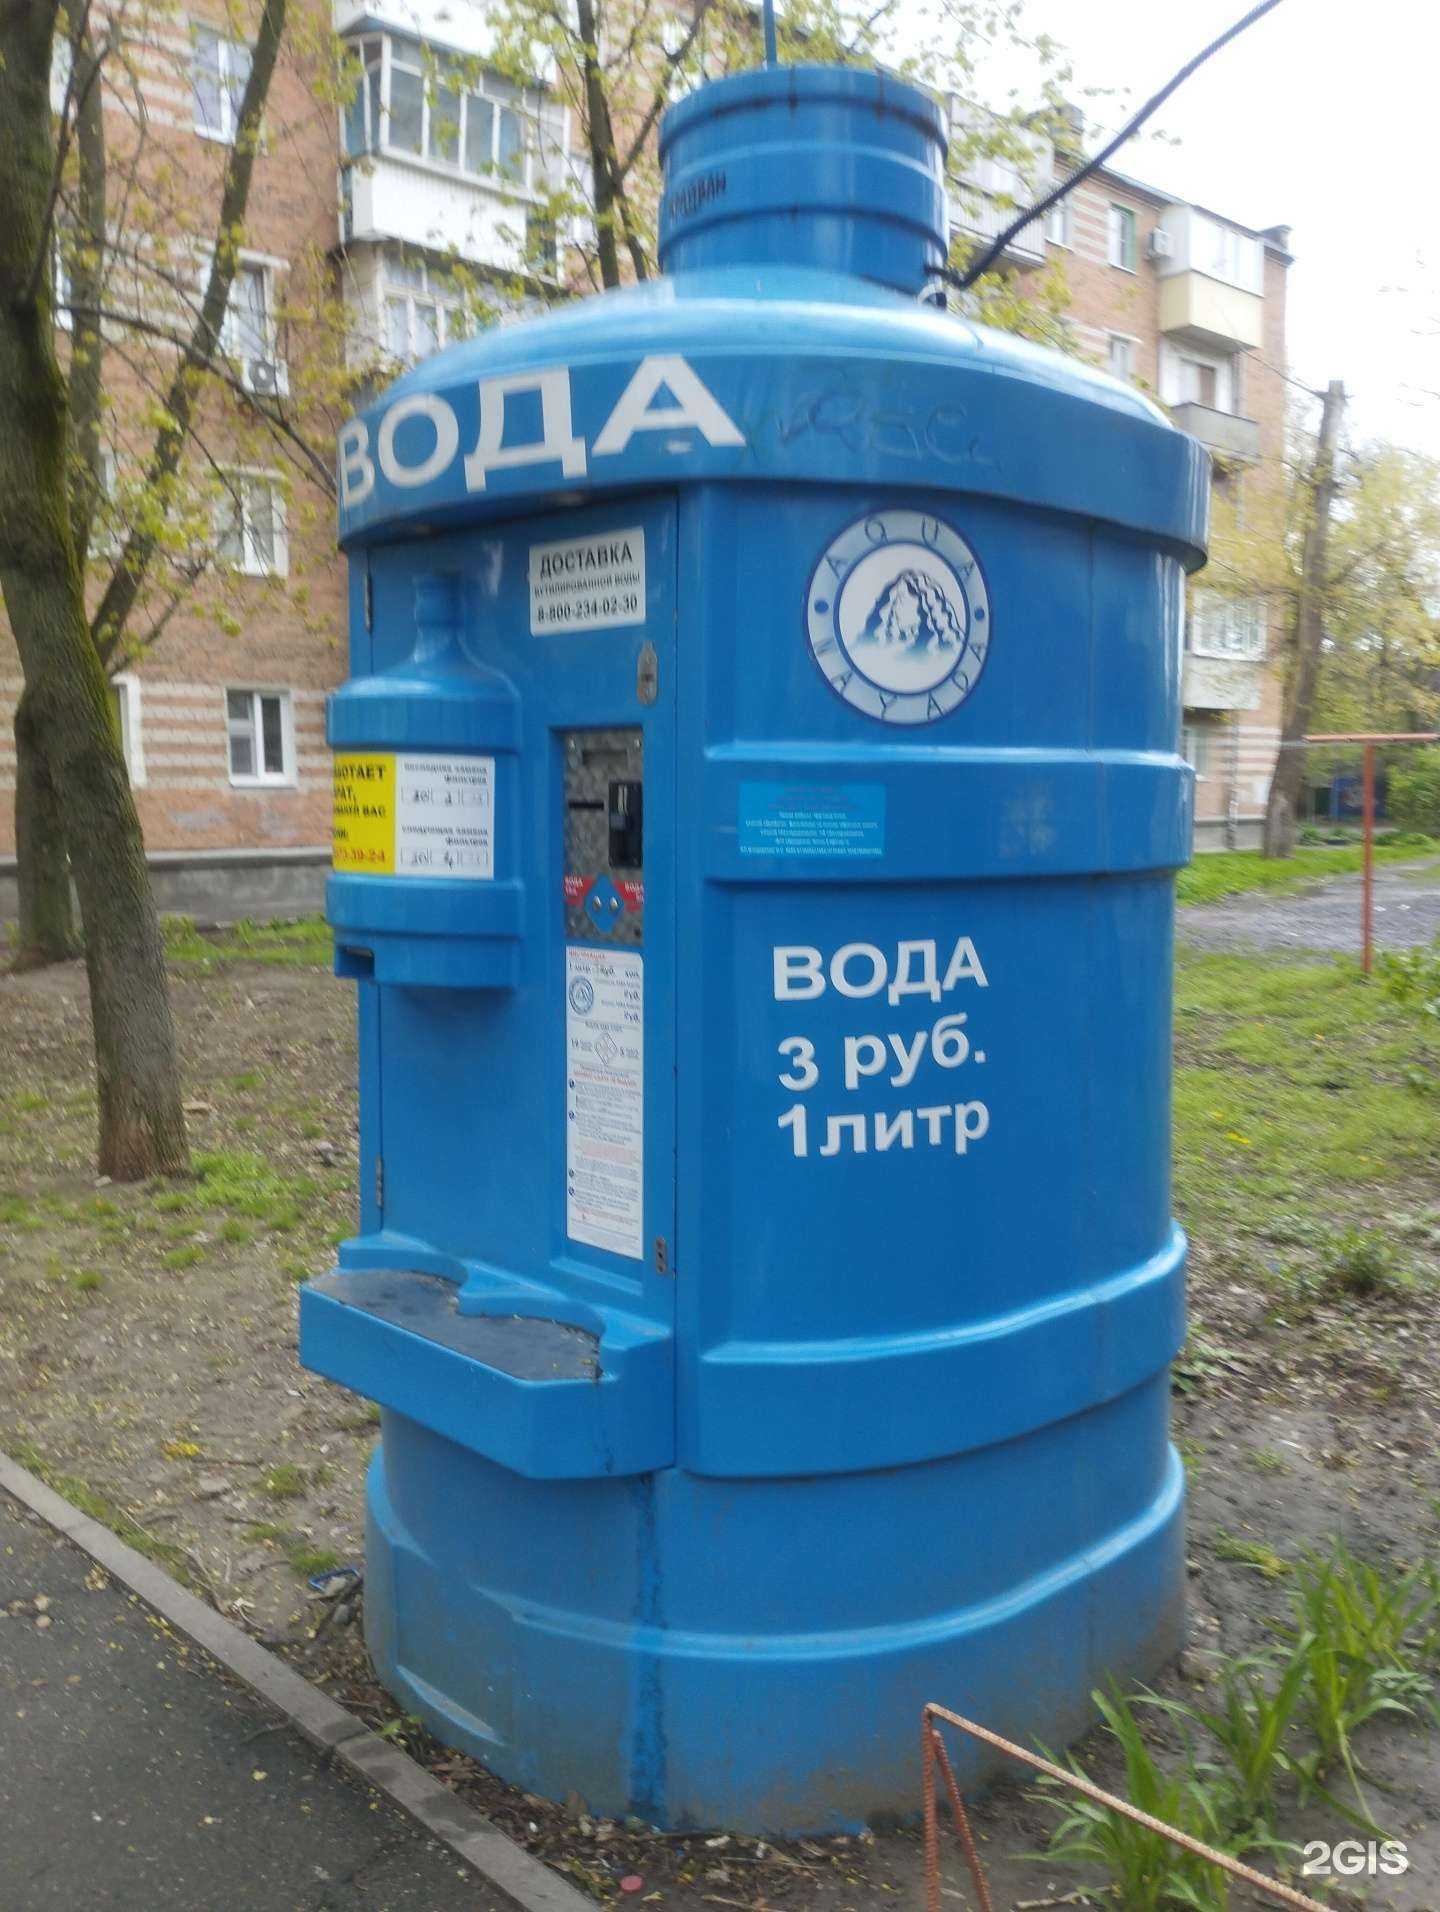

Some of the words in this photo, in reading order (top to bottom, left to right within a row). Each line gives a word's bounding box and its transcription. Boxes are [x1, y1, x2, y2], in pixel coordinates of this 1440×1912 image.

[337, 353, 747, 508] ВОДА
[540, 541, 633, 579] ДОСТАВКА
[826, 514, 976, 580] AQUA
[773, 936, 989, 1006] ВОДА
[777, 1036, 820, 1092] 3
[844, 1012, 986, 1090] руб.
